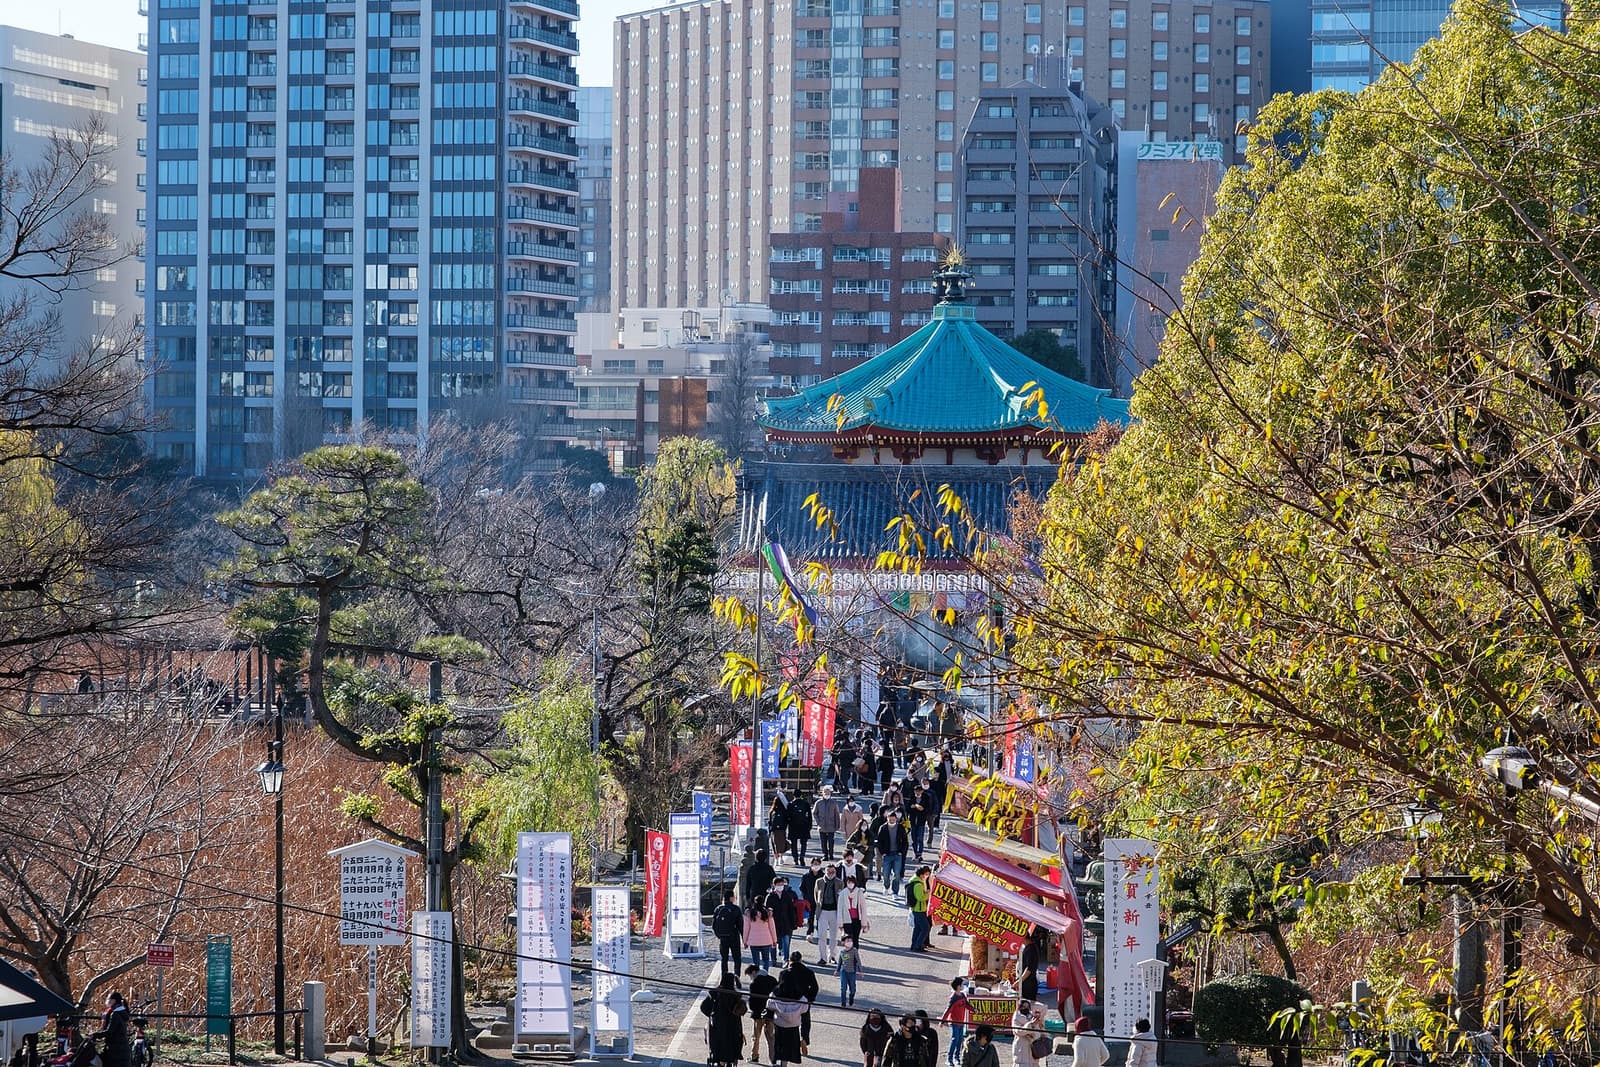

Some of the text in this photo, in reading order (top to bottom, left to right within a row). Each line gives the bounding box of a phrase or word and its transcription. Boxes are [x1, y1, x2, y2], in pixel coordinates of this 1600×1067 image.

[1138, 143, 1218, 158] クミアイ化学
[699, 799, 710, 859] 谷中七福神
[356, 857, 365, 893] 四月三日
[363, 855, 371, 893] 三月十日
[384, 857, 393, 890] 令和三年
[397, 856, 405, 889] 令和三年
[341, 857, 351, 939] 六月二日 十二月十一日
[348, 856, 358, 939] 五月九日 十一月五日
[369, 856, 378, 939] 二月二日 八月日
[376, 857, 385, 939] 一月九日 七月八日
[390, 882, 398, 924] 九月十八日
[559, 857, 567, 931] ご参拝される皆さまへ
[933, 882, 1029, 937] ISTANBUL KEBAB
[940, 902, 1007, 936] 本場トルコの味！
[997, 999, 1016, 1014] KEBAB
[1109, 986, 1118, 1007] 不忍池
